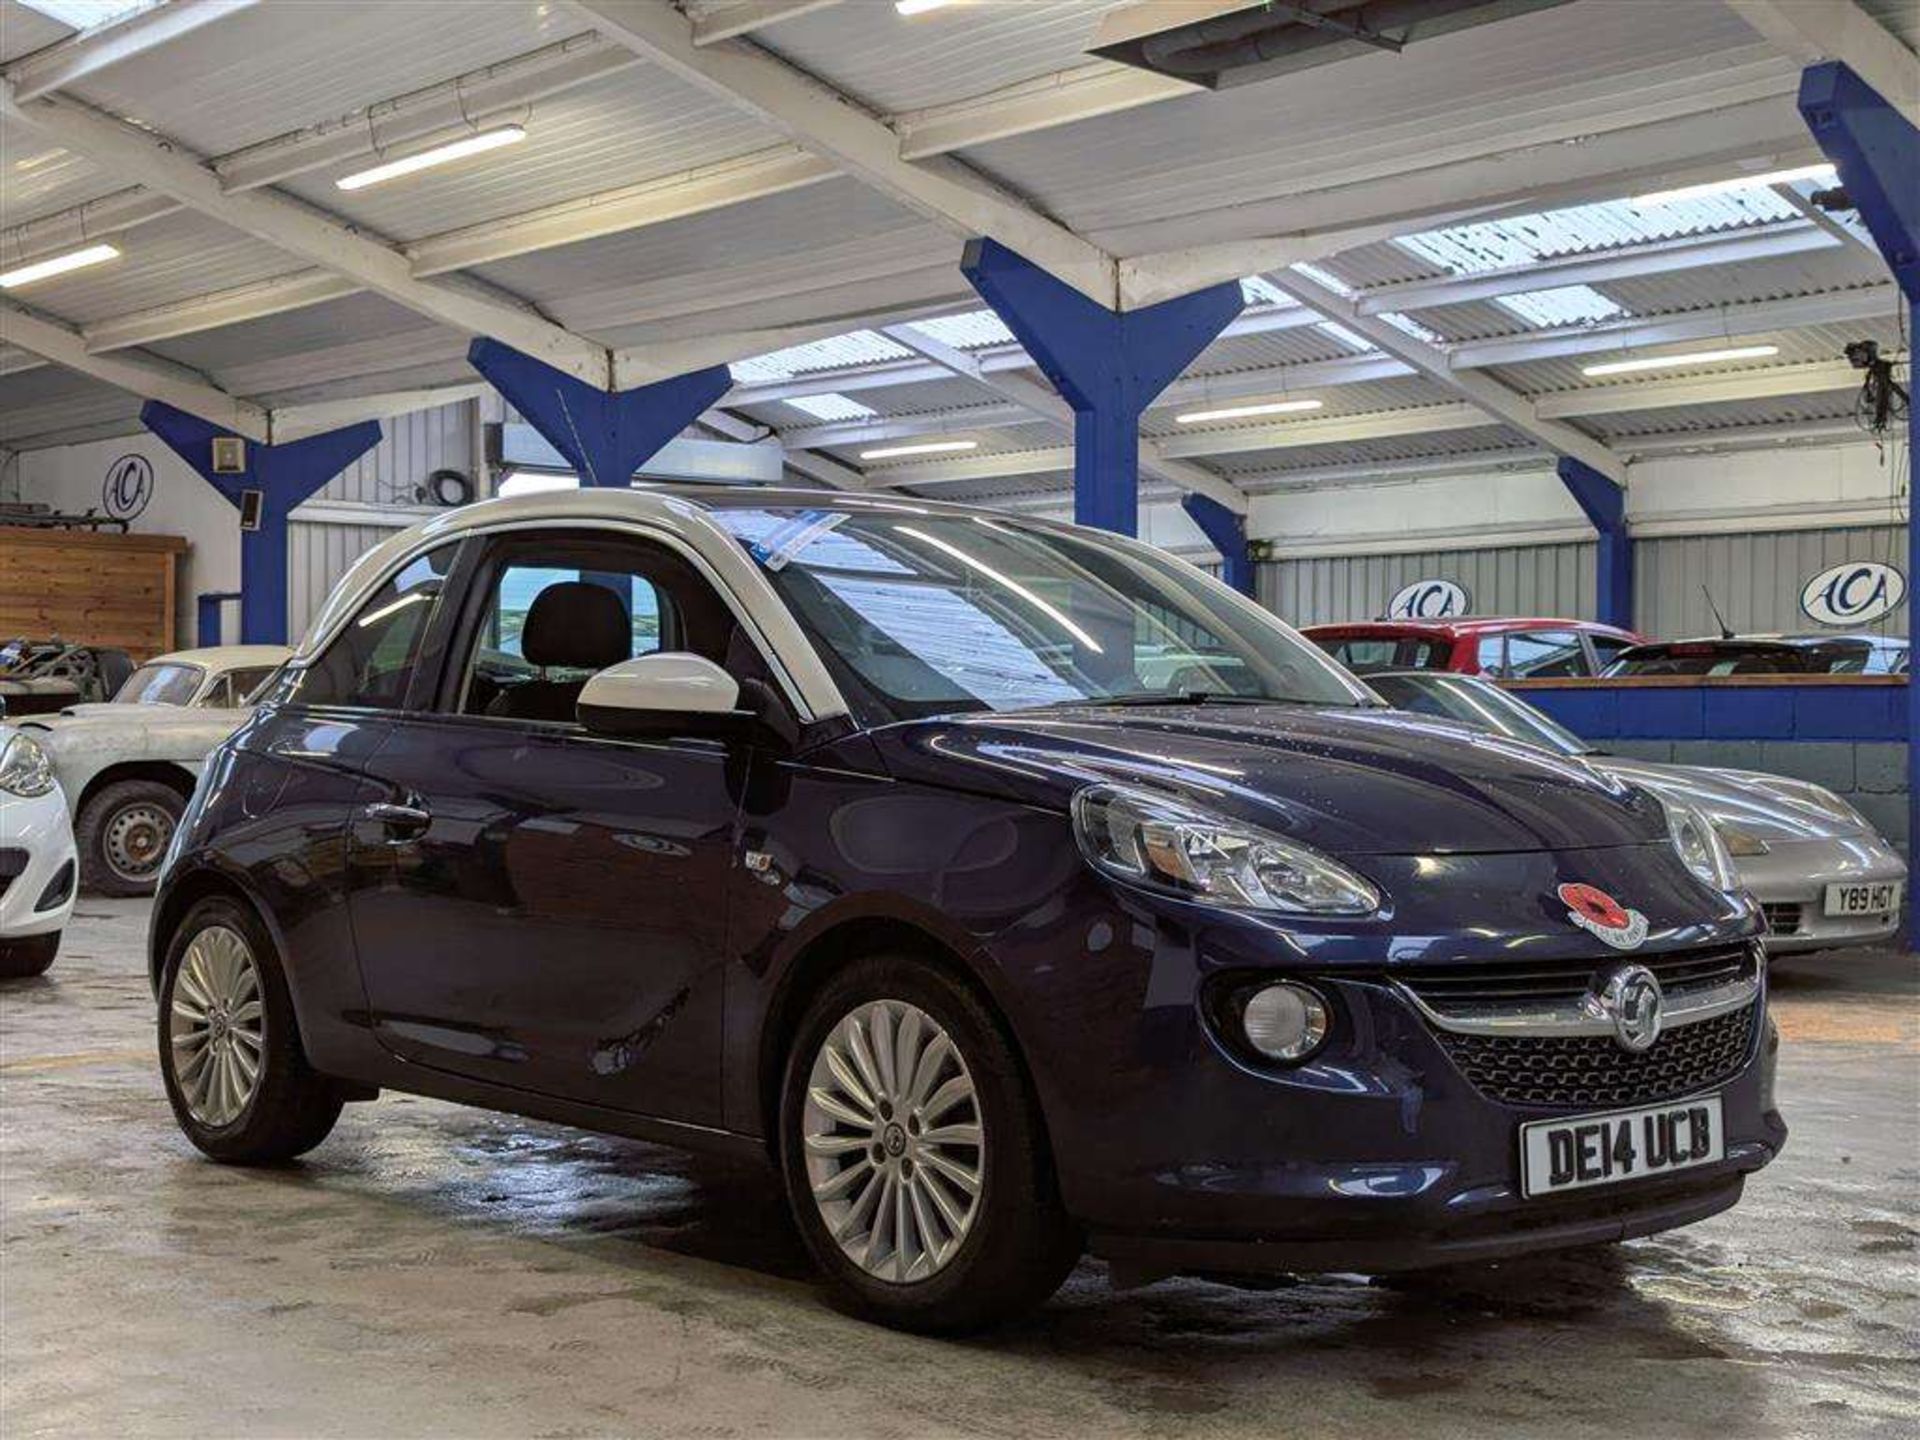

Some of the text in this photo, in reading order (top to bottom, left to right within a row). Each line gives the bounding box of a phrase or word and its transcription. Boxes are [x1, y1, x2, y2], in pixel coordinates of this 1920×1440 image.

[106, 462, 146, 512] ACA
[1393, 584, 1455, 617] ACA
[1807, 567, 1889, 616] ACA
[1839, 887, 1869, 910] Y89
[1548, 1107, 1710, 1186] DE14 UCB
